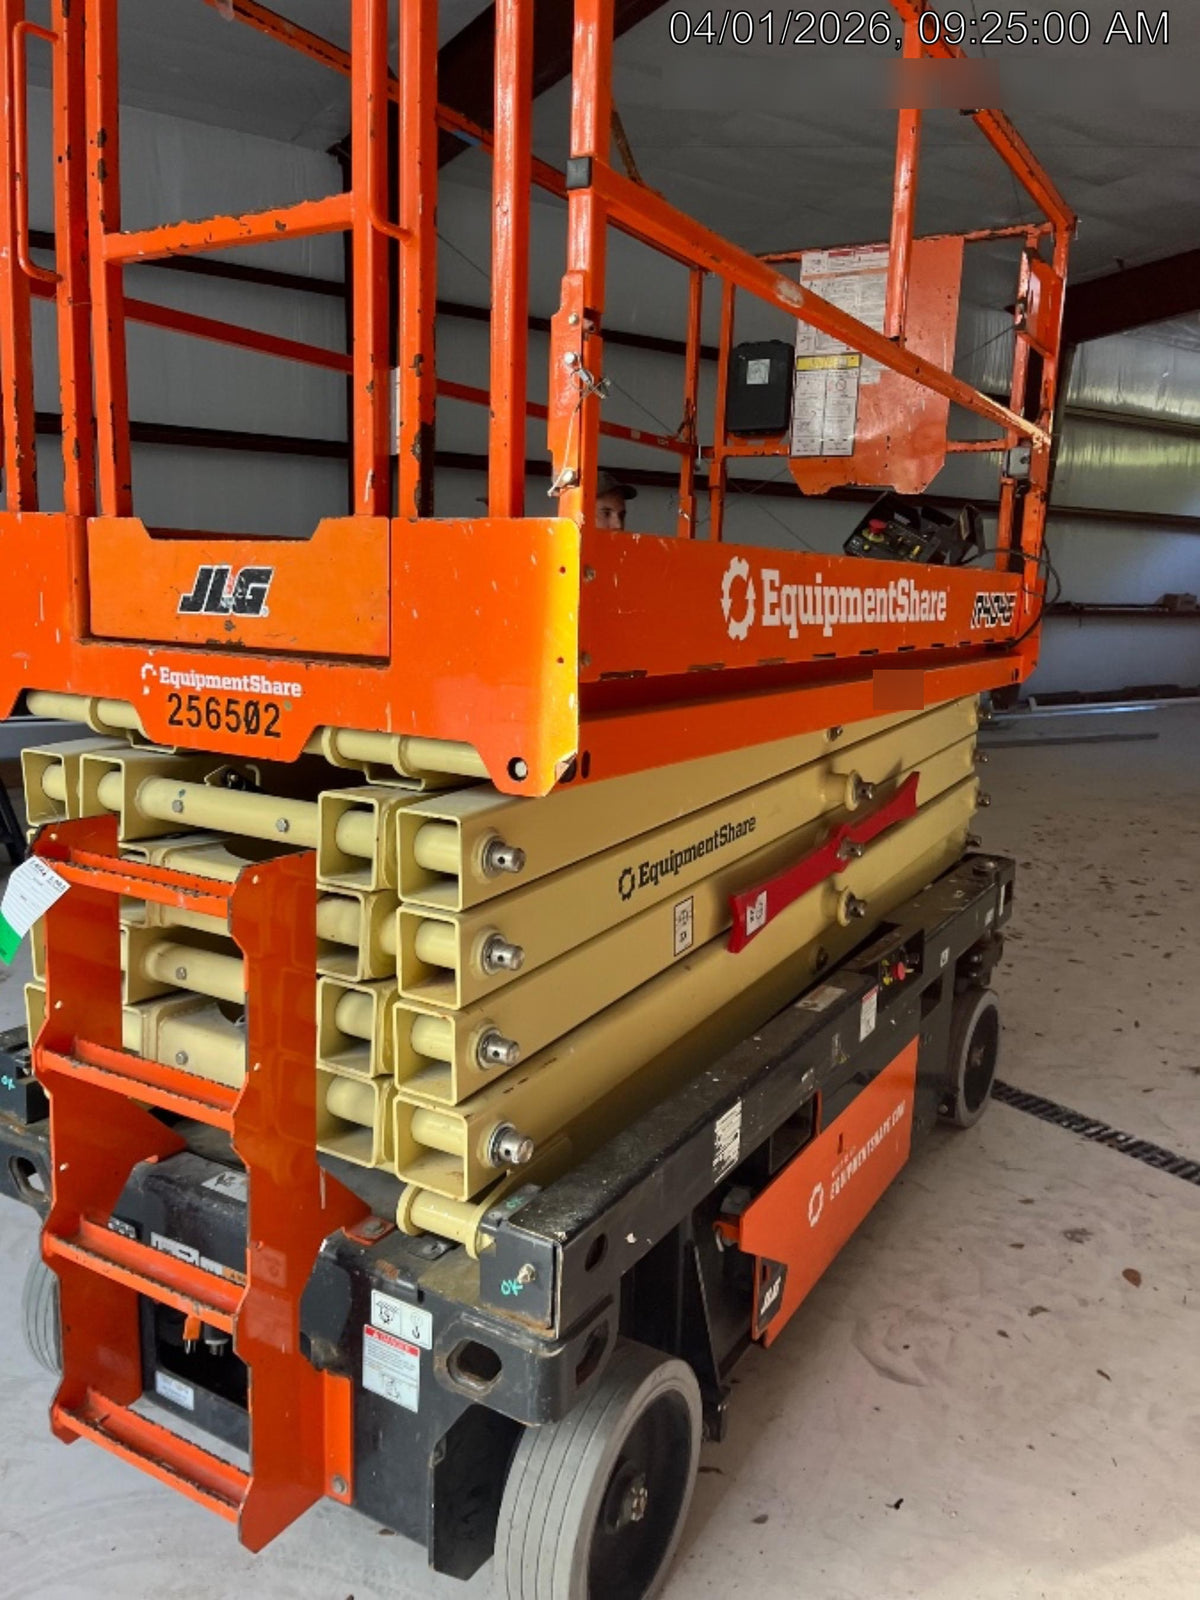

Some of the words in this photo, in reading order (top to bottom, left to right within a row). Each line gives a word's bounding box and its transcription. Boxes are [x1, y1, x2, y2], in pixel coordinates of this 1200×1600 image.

[177, 565, 274, 617] JLG
[760, 568, 947, 639] EquipmentShare
[159, 666, 302, 697] EquipmentShare
[167, 692, 282, 738] 256502
[638, 816, 756, 888] EquipmentShare
